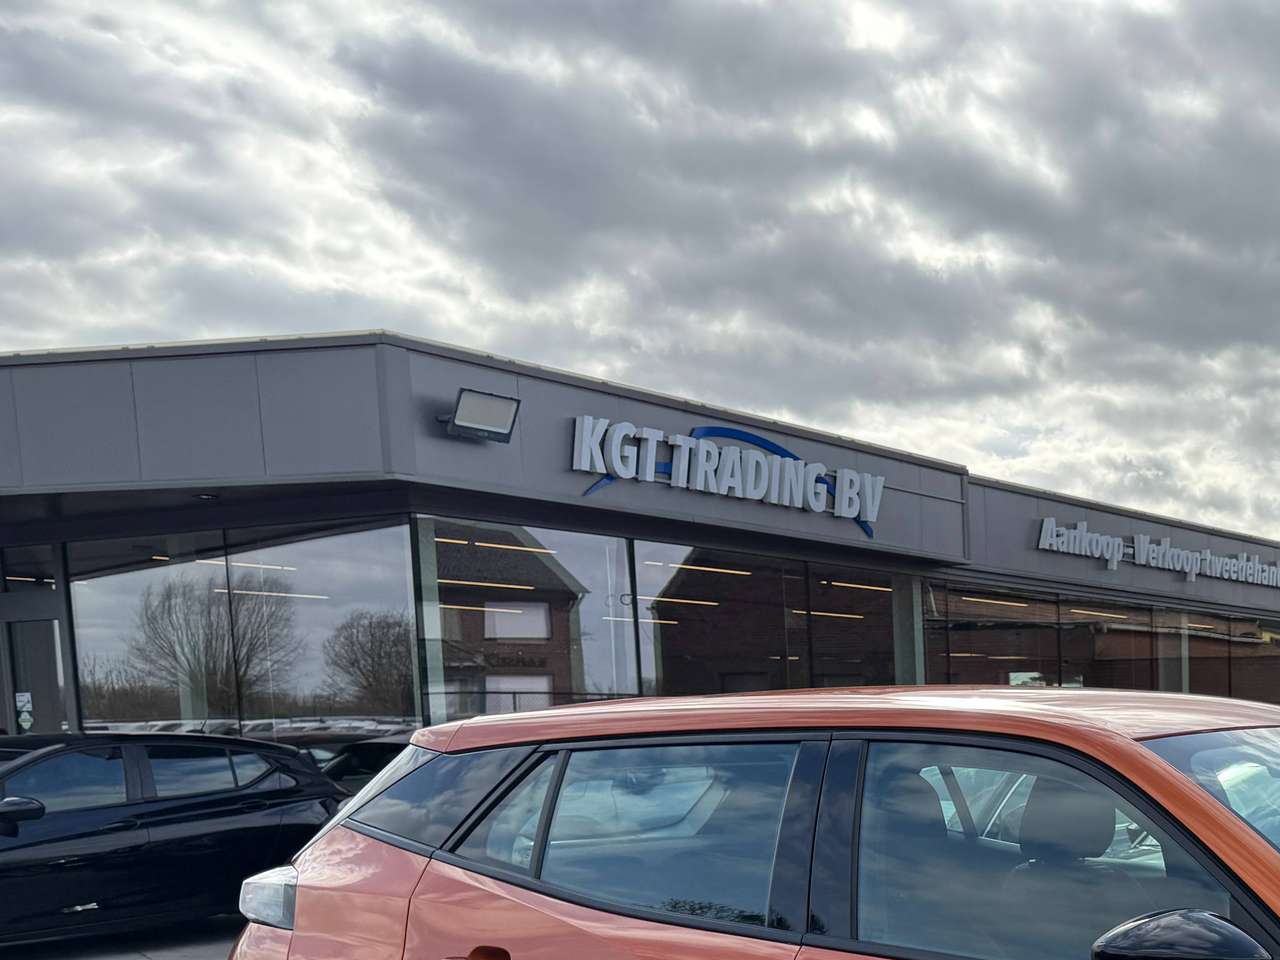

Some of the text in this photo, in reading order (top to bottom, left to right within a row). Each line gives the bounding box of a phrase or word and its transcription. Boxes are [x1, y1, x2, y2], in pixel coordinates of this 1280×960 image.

[573, 415, 885, 522] KGT TRADING BV
